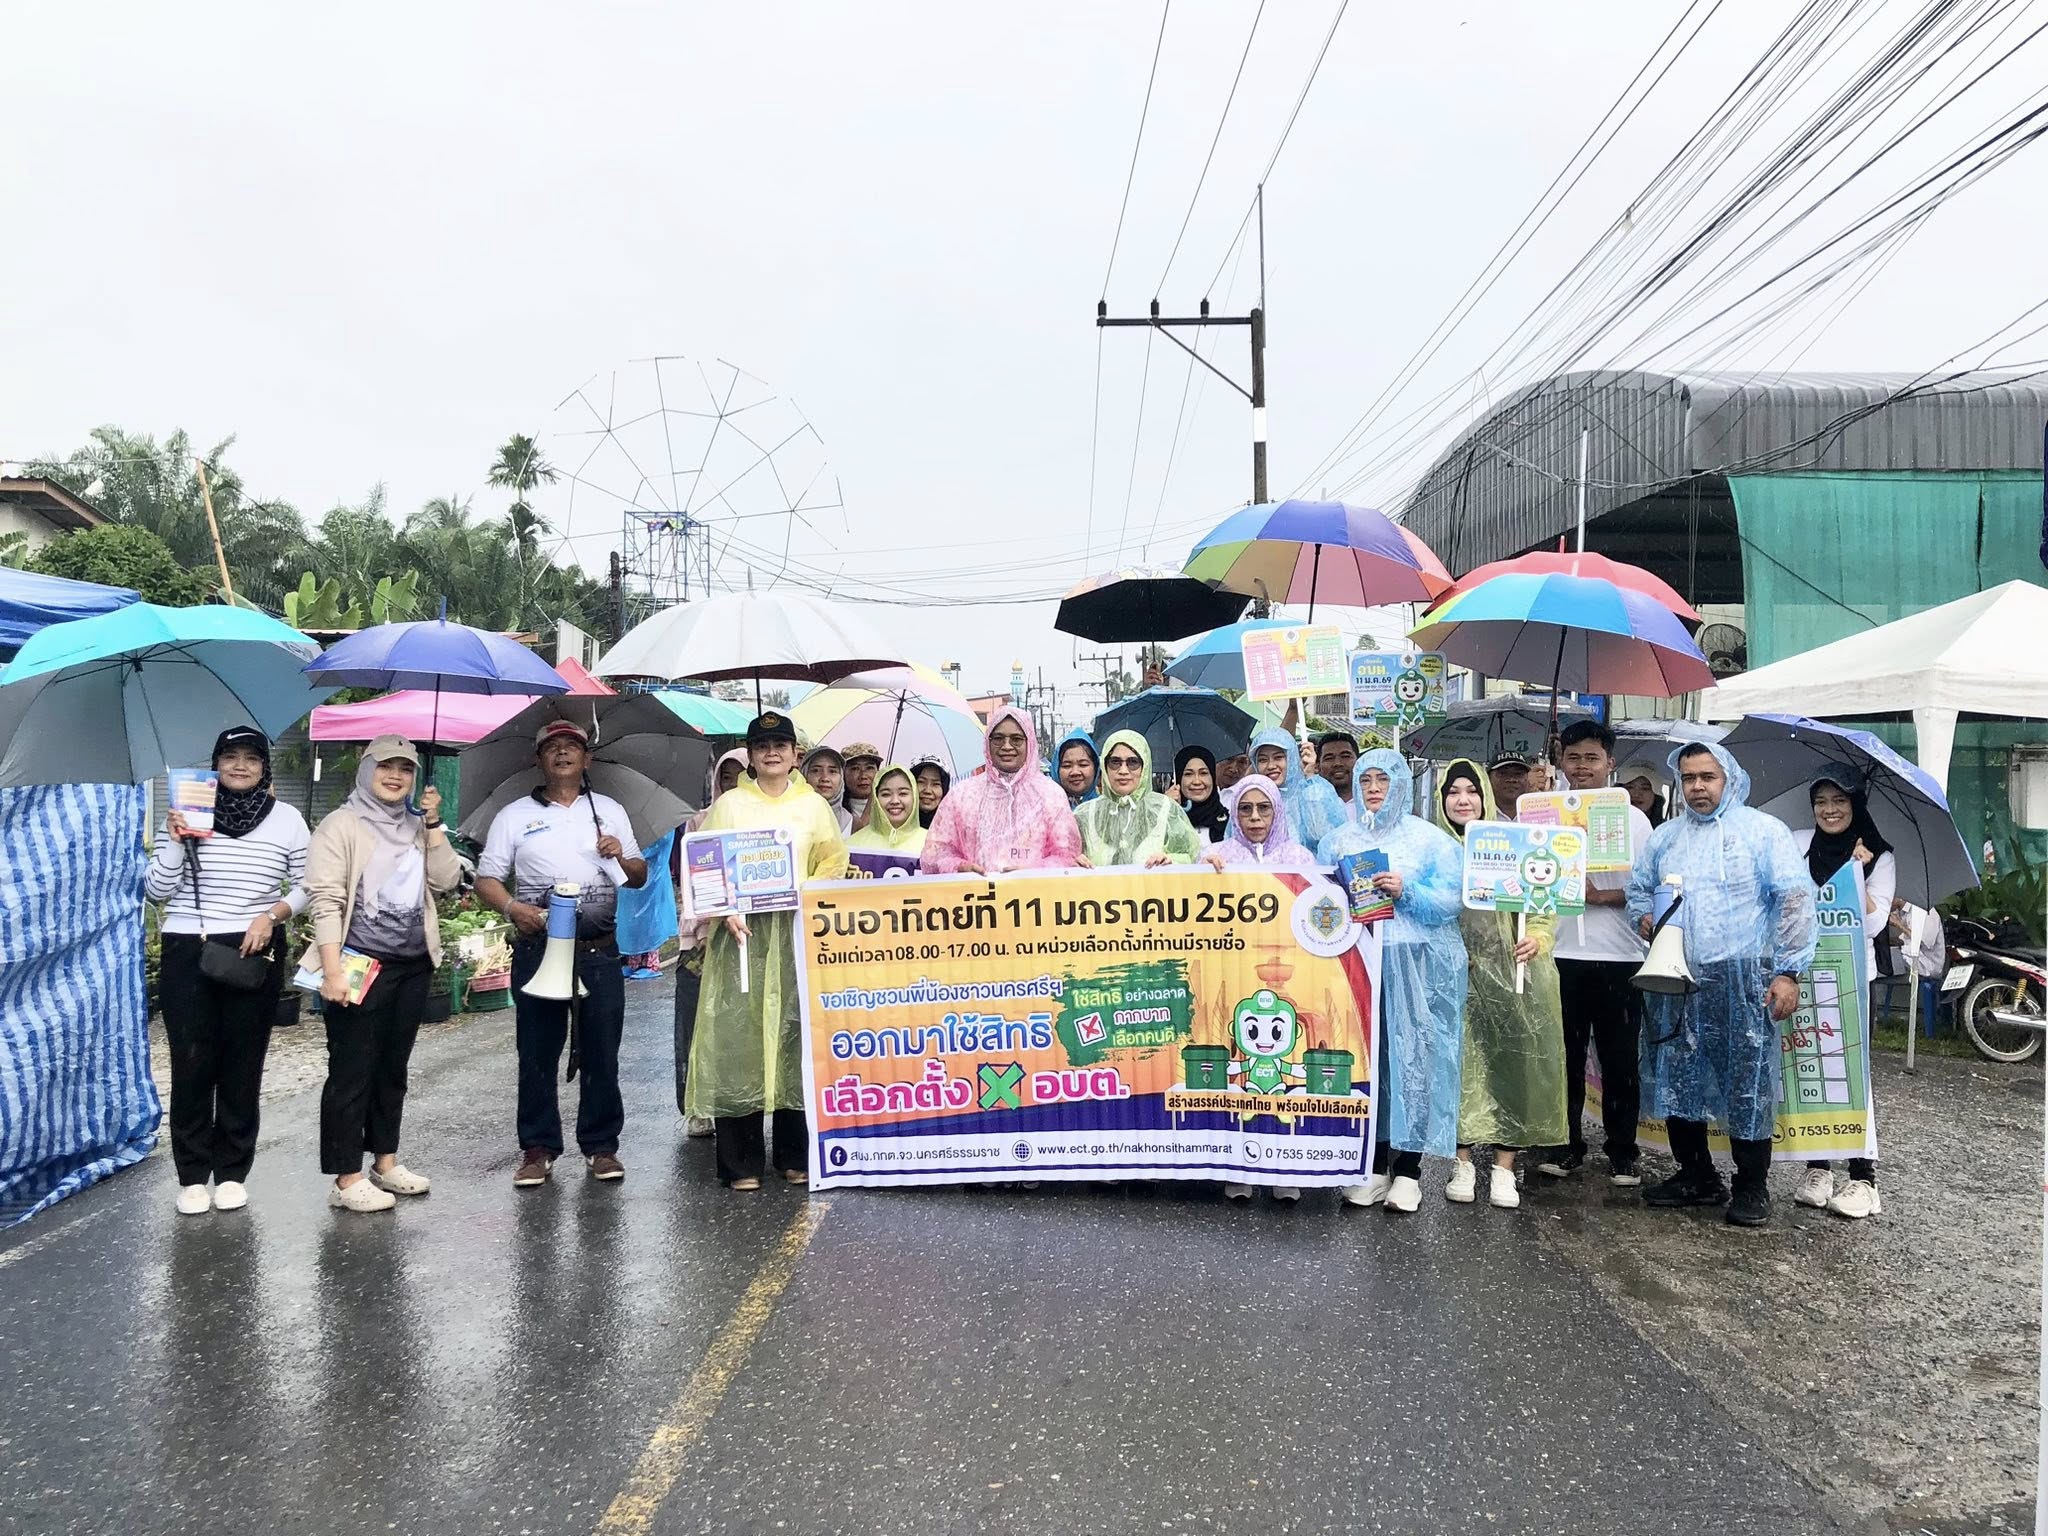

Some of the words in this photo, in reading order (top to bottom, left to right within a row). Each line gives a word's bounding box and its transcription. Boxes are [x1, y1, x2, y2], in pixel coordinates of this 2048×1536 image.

[728, 839, 758, 849] SMART
[741, 860, 786, 881] ครบ
[813, 882, 997, 938] วันอาทิตย์ที่
[1005, 898, 1041, 928] 11
[1055, 897, 1189, 926] มกราคม
[1196, 892, 1279, 923] 2569
[817, 942, 893, 965] ตั้งแต่เวลา
[896, 943, 990, 960] 08.00-17.00
[995, 944, 1010, 956] น.
[1015, 942, 1033, 956] ณ
[1038, 928, 1245, 954] หน่วยเลือกตั้งที่ท่านมีรายชื่อ
[821, 976, 1062, 1010] ขอเชิญชวนพี่น้องชาวนครศรีฯ
[1072, 988, 1121, 1007] ใช้สิทธิ
[1125, 987, 1186, 1002] อย่างฉลาด
[1114, 1007, 1170, 1024] กากบาท
[1795, 1015, 1811, 1024] 00
[832, 1014, 1051, 1058] ออกมาใช้สิทธิ
[1113, 1026, 1175, 1046] เลือกคนดี
[1256, 1068, 1275, 1077] ECT
[1800, 1064, 1815, 1073] 00
[824, 1062, 969, 1113] เลือกตั้ง
[1035, 1071, 1126, 1099] อบต.
[1803, 1088, 1818, 1097] 00
[1168, 1095, 1271, 1111] สร้างสรรค์ประเทศไทย
[1277, 1098, 1368, 1115] พร้อมใจไปเลือกตั้ง
[1788, 1127, 1796, 1138] 0
[1799, 1125, 1831, 1136] 7535
[1037, 1143, 1232, 1156] www.ect.go.th/nakhonsithammarat
[1266, 1148, 1273, 1159] 0
[1276, 1148, 1306, 1160] 7535
[1307, 1149, 1358, 1161] 5299-300
